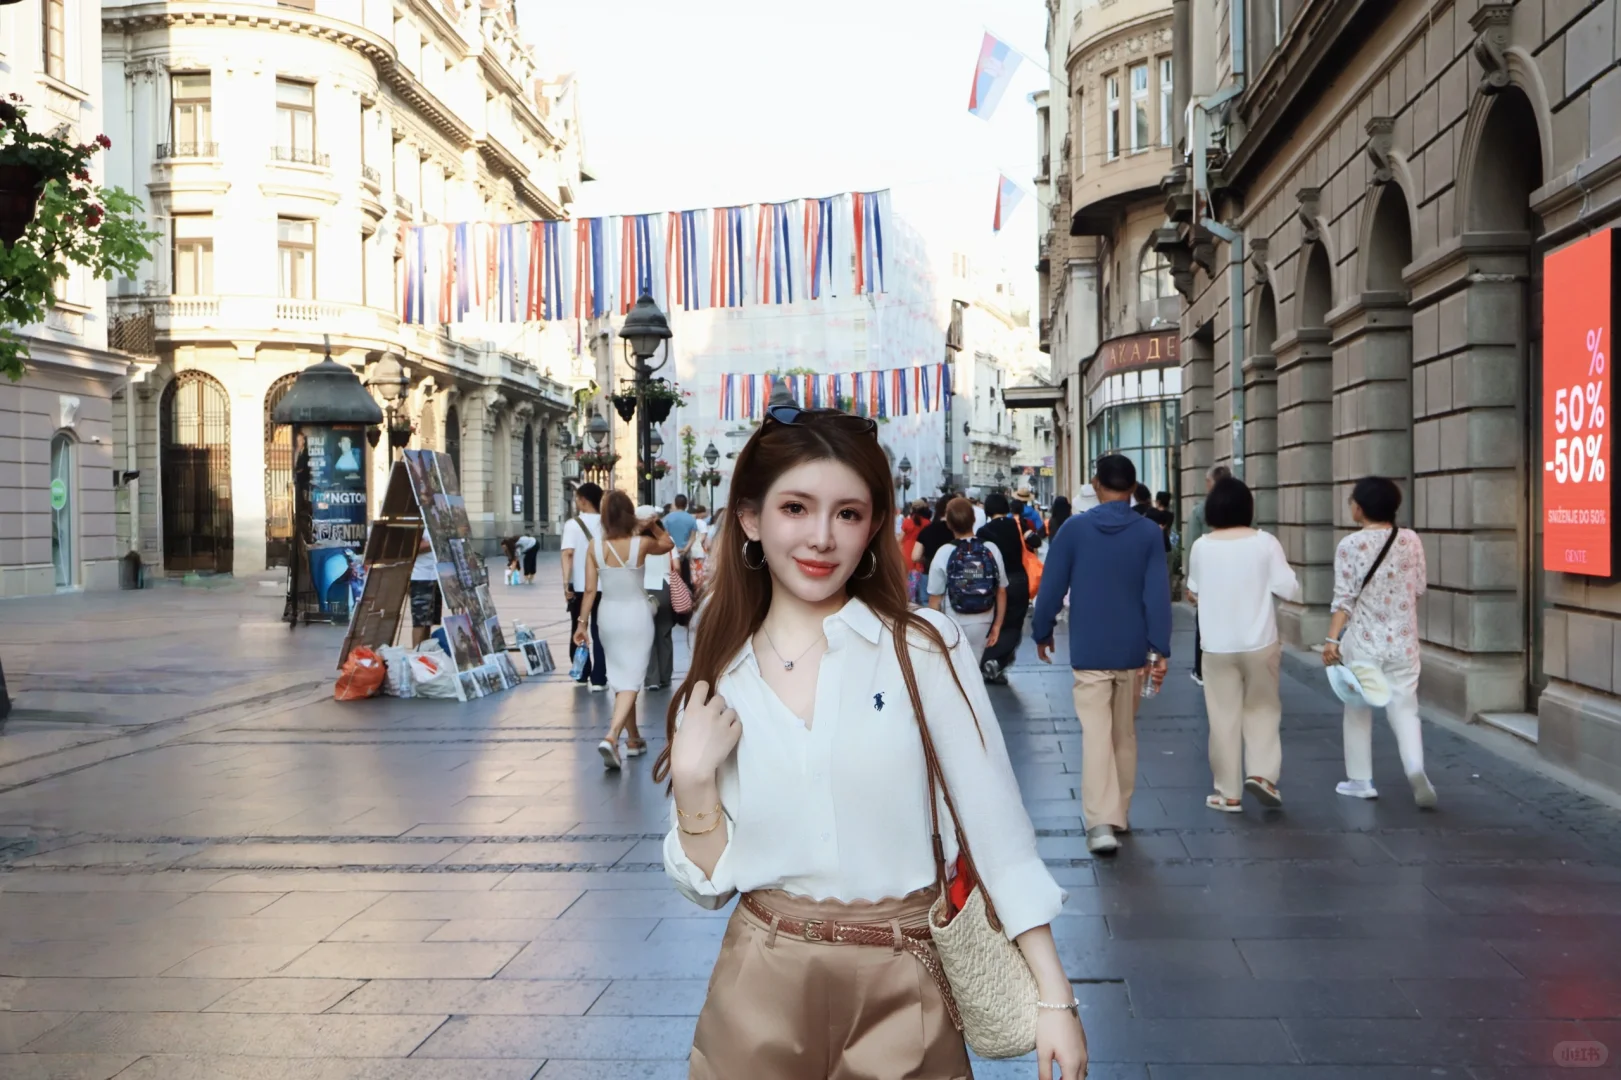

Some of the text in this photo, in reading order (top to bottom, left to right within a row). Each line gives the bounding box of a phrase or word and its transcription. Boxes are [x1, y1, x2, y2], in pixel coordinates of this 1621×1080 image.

[1555, 380, 1605, 434] 50%
[1545, 434, 1606, 484] -50%
[1548, 506, 1606, 524] SNIŽENJE DO 50%
